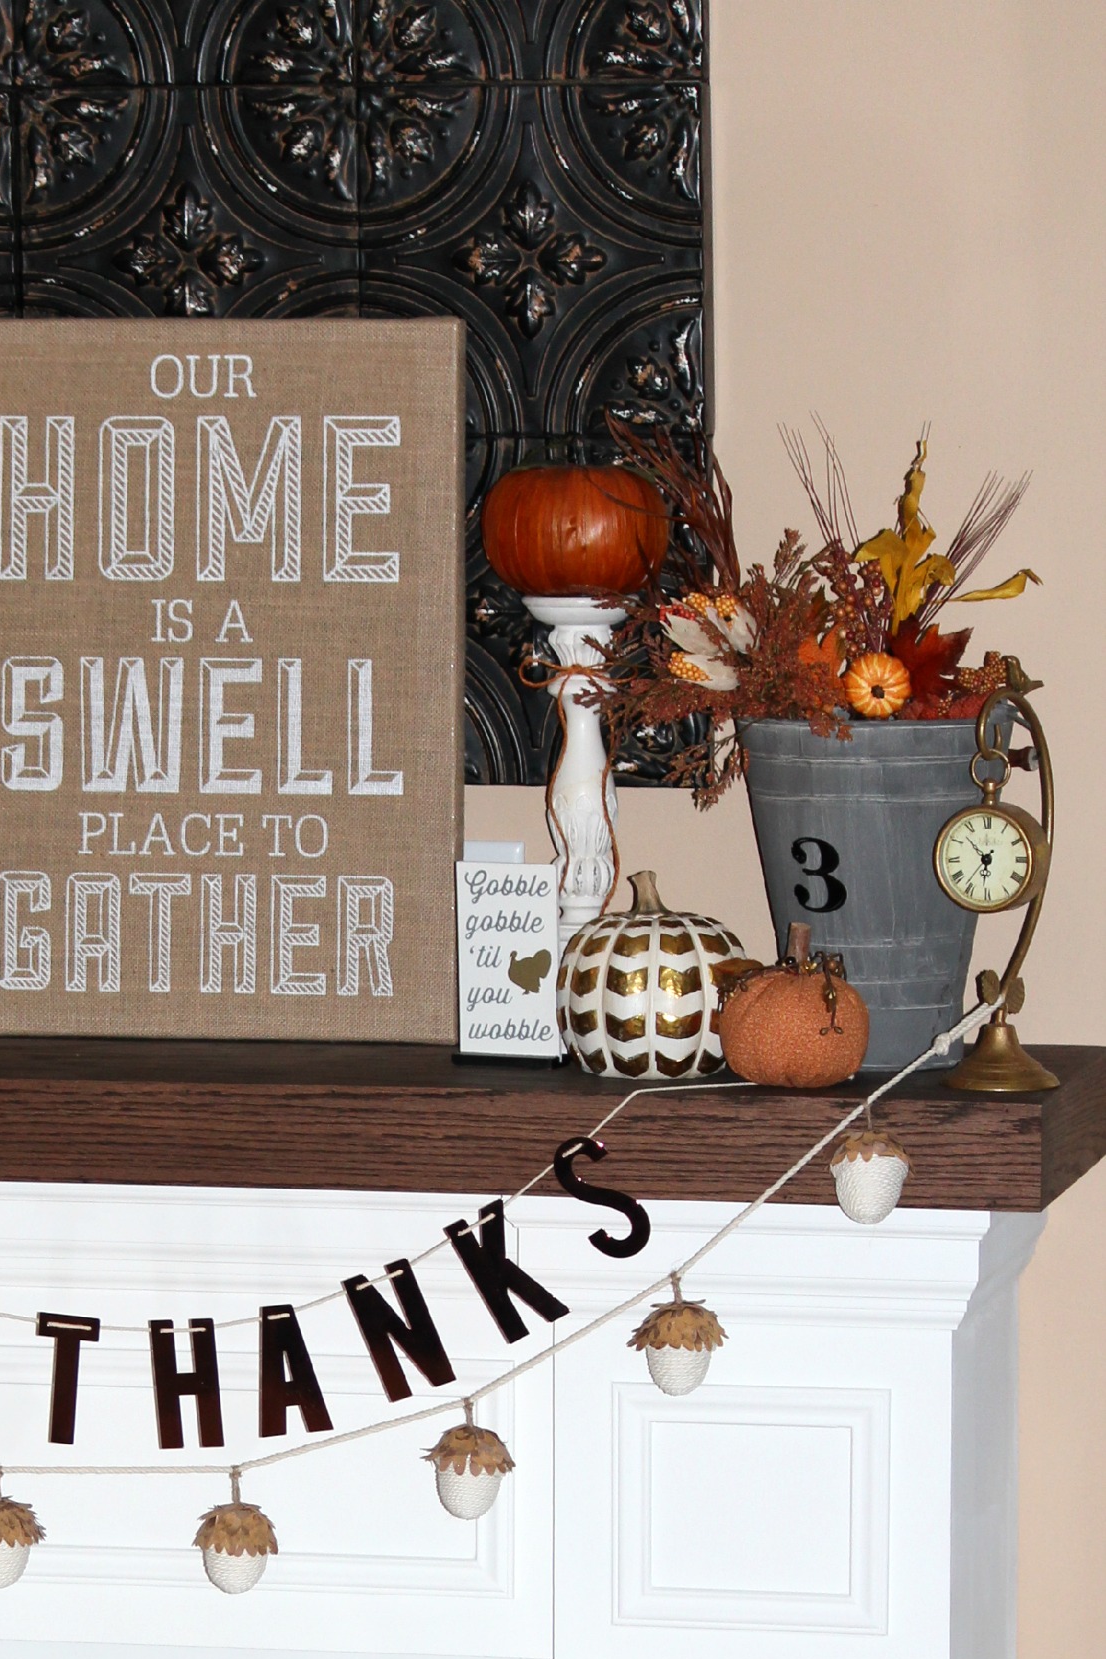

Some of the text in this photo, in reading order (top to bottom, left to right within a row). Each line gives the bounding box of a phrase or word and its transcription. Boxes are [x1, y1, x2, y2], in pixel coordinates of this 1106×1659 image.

[150, 353, 257, 399] OUR
[150, 599, 254, 643] IS A
[1, 655, 405, 796] SWELL
[78, 812, 329, 858] PLACE TO
[464, 869, 551, 904] Gobble
[791, 836, 848, 913] 3
[465, 910, 545, 940] gobble
[466, 986, 513, 1012] you
[468, 1018, 554, 1042] wobble
[36, 1136, 651, 1450] THANKS
